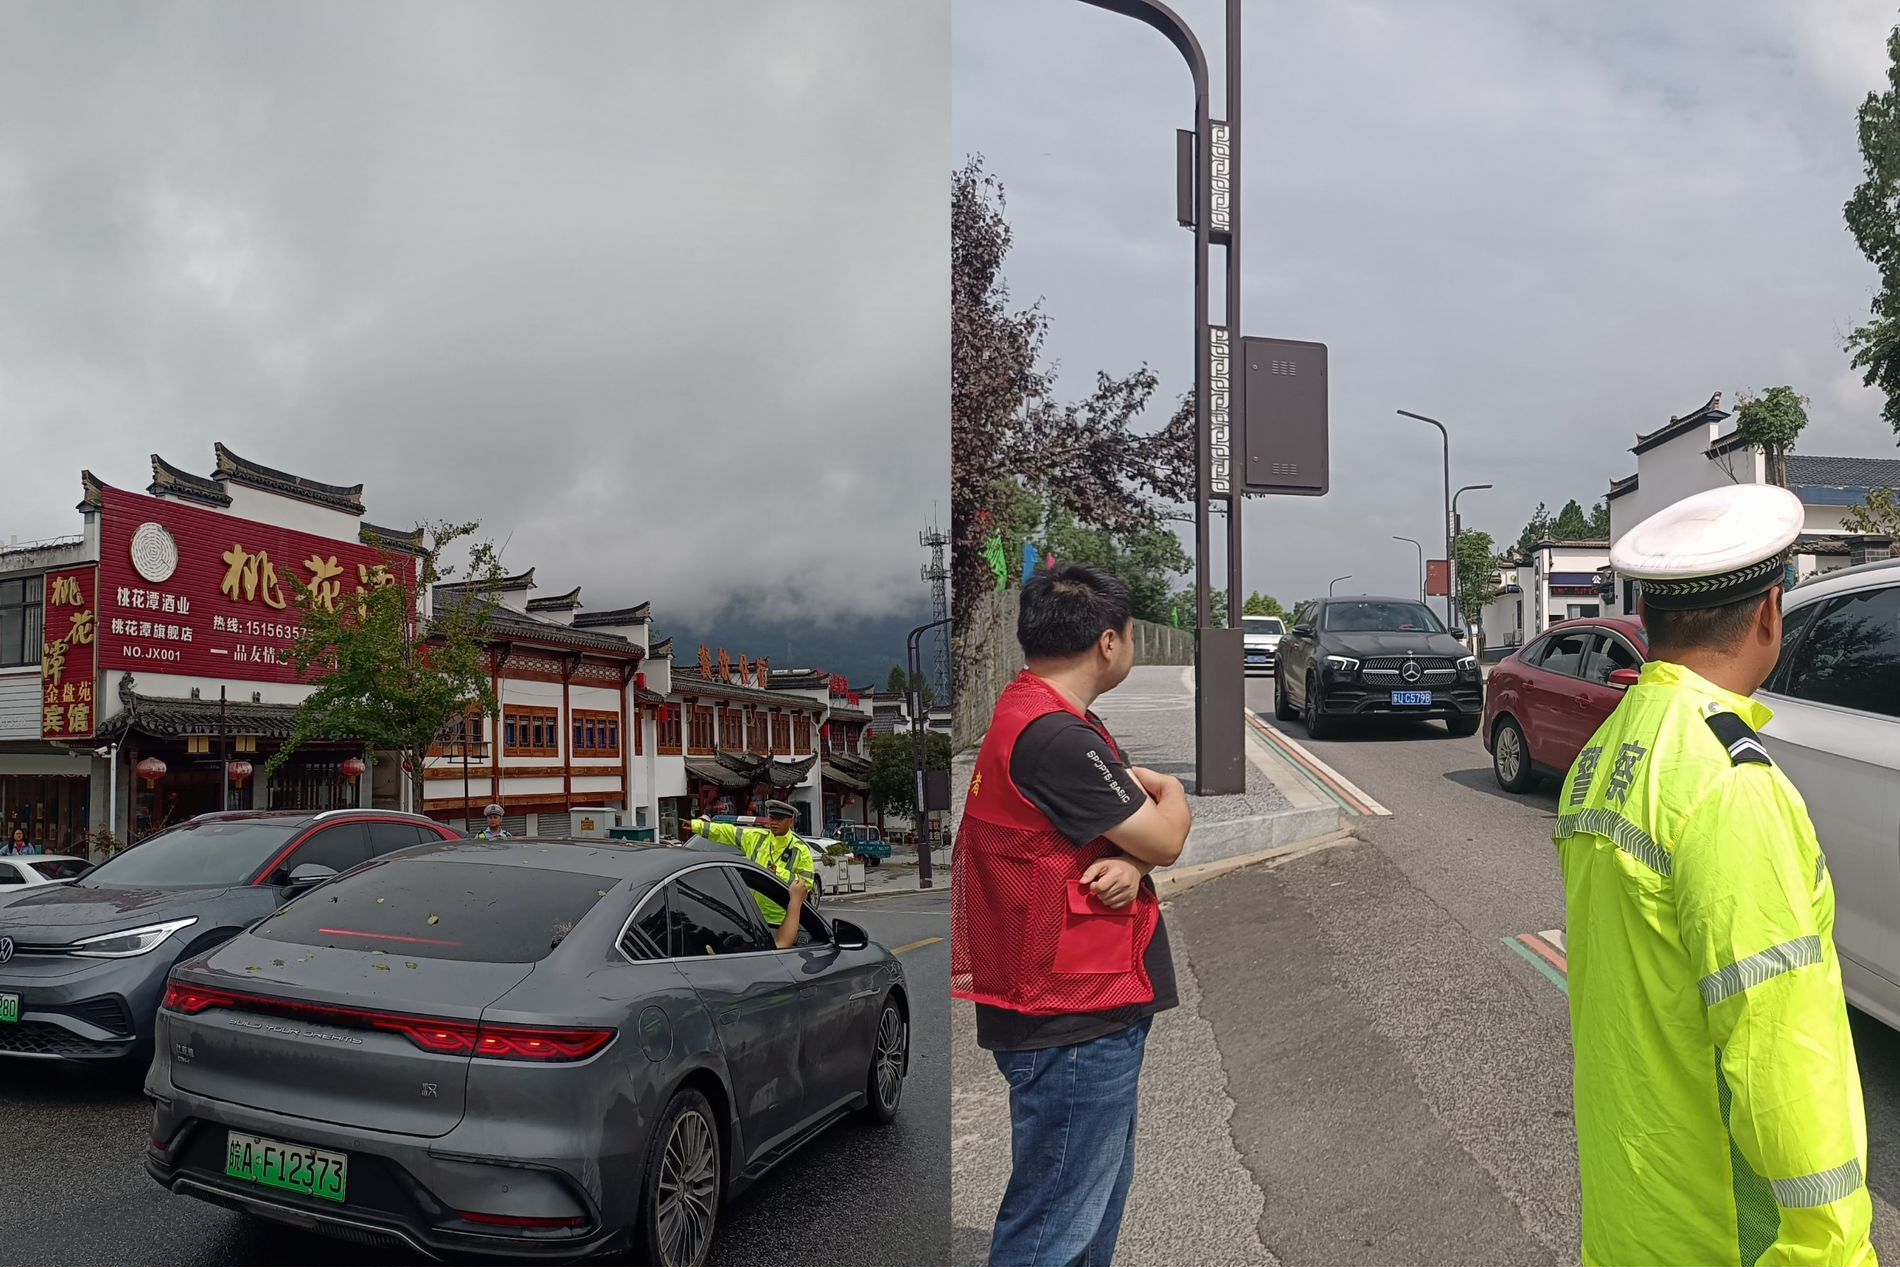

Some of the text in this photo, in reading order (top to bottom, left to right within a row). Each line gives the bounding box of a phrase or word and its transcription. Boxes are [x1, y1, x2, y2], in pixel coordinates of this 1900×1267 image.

[116, 587, 190, 615] 桃花潭酒业
[43, 576, 94, 687] 桃花潭
[111, 618, 193, 642] 桃花潭旗舰店
[123, 645, 181, 662] NO.JX001
[46, 681, 92, 704] 金盘苑
[43, 704, 91, 733] 宾馆
[1570, 739, 1648, 807] 警察
